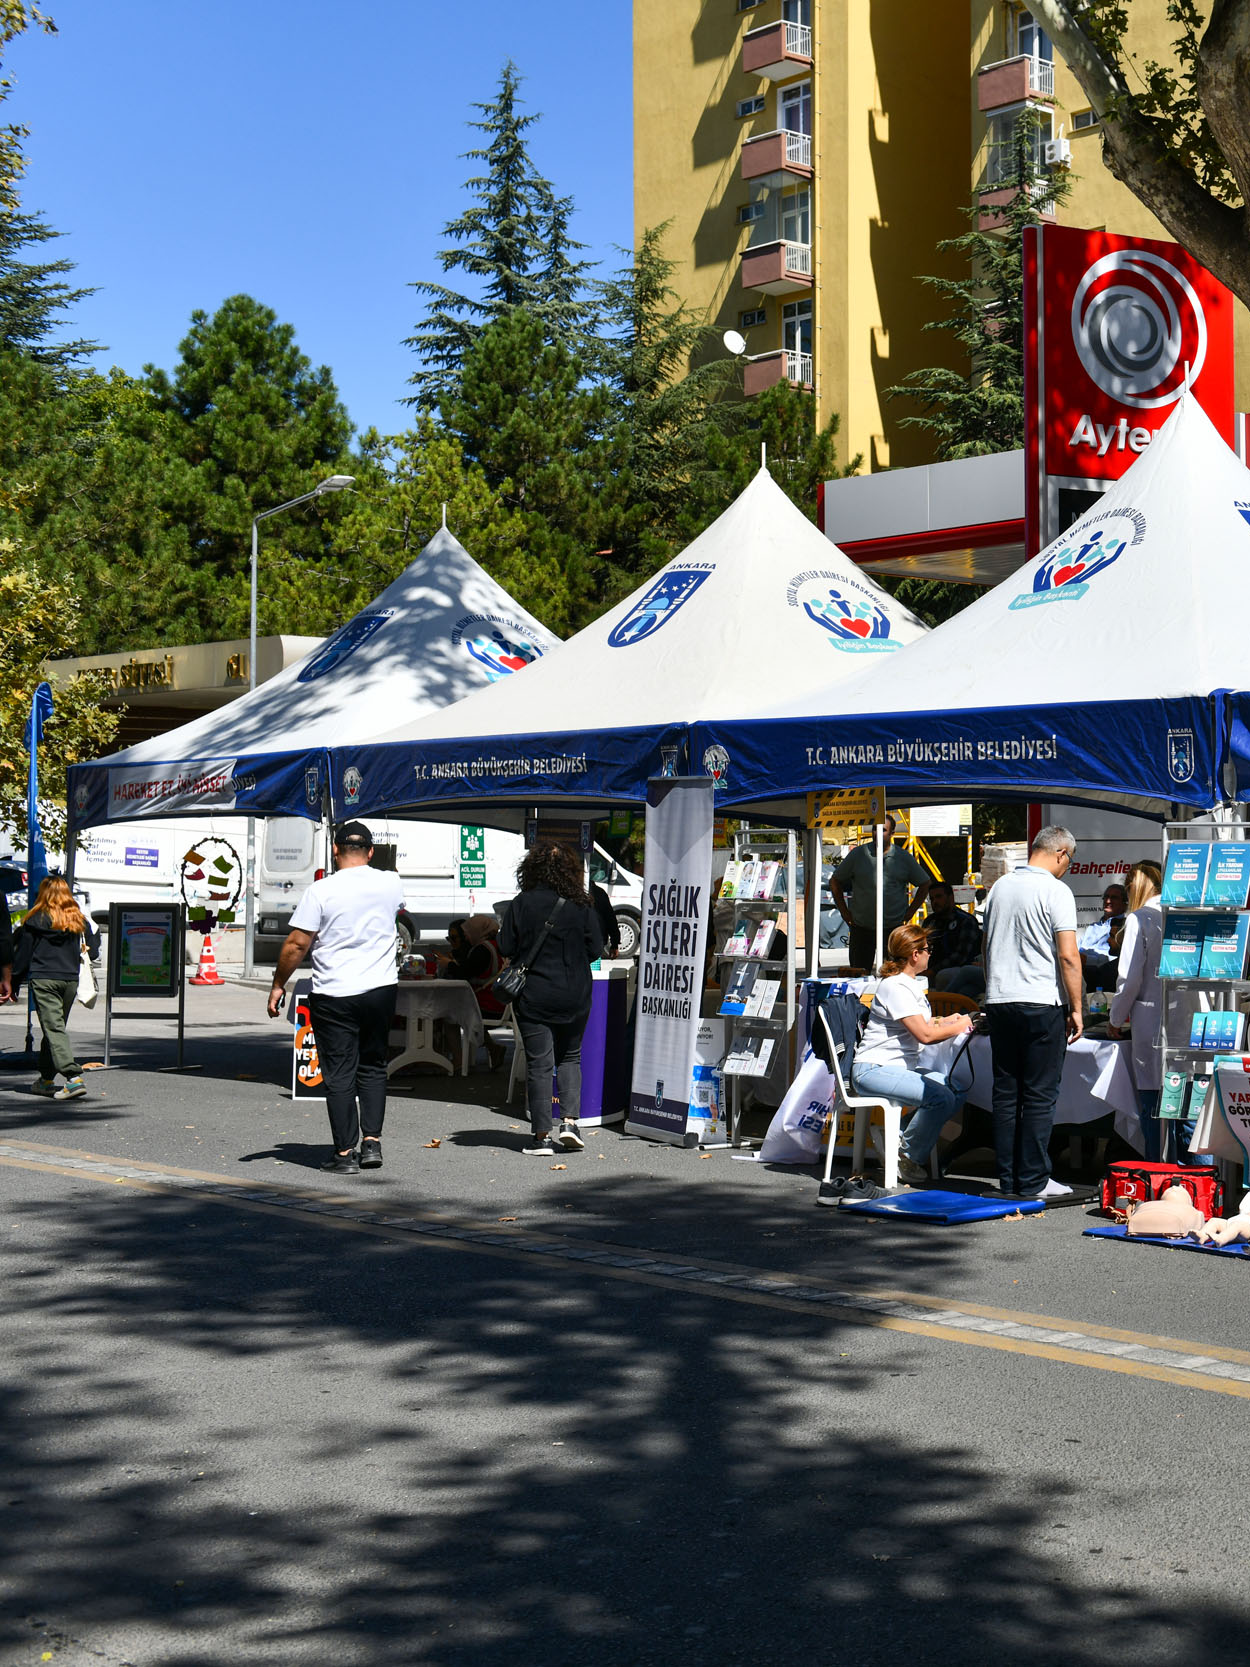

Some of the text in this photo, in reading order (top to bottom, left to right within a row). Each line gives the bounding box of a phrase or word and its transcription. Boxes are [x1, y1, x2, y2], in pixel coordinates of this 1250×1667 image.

[669, 562, 717, 571] ANKARA
[806, 734, 1057, 765] T.C. ANKARA BÜYÜKŞEHİR BELEDİYESİ
[414, 752, 588, 780] T.C. ANKARA BÜYÜKŞEHİR BELEDİYESİ
[113, 780, 159, 801] HAREKET
[230, 774, 256, 792] DİYESİ
[1070, 860, 1130, 877] Bahçelie
[649, 878, 701, 919] SAĞLIK
[646, 918, 698, 960] İŞLERİ
[643, 961, 694, 994] DAİRESİ
[641, 995, 692, 1021] BAŞKANLIĞI
[295, 1049, 318, 1061] YET
[299, 1065, 322, 1077] OLM
